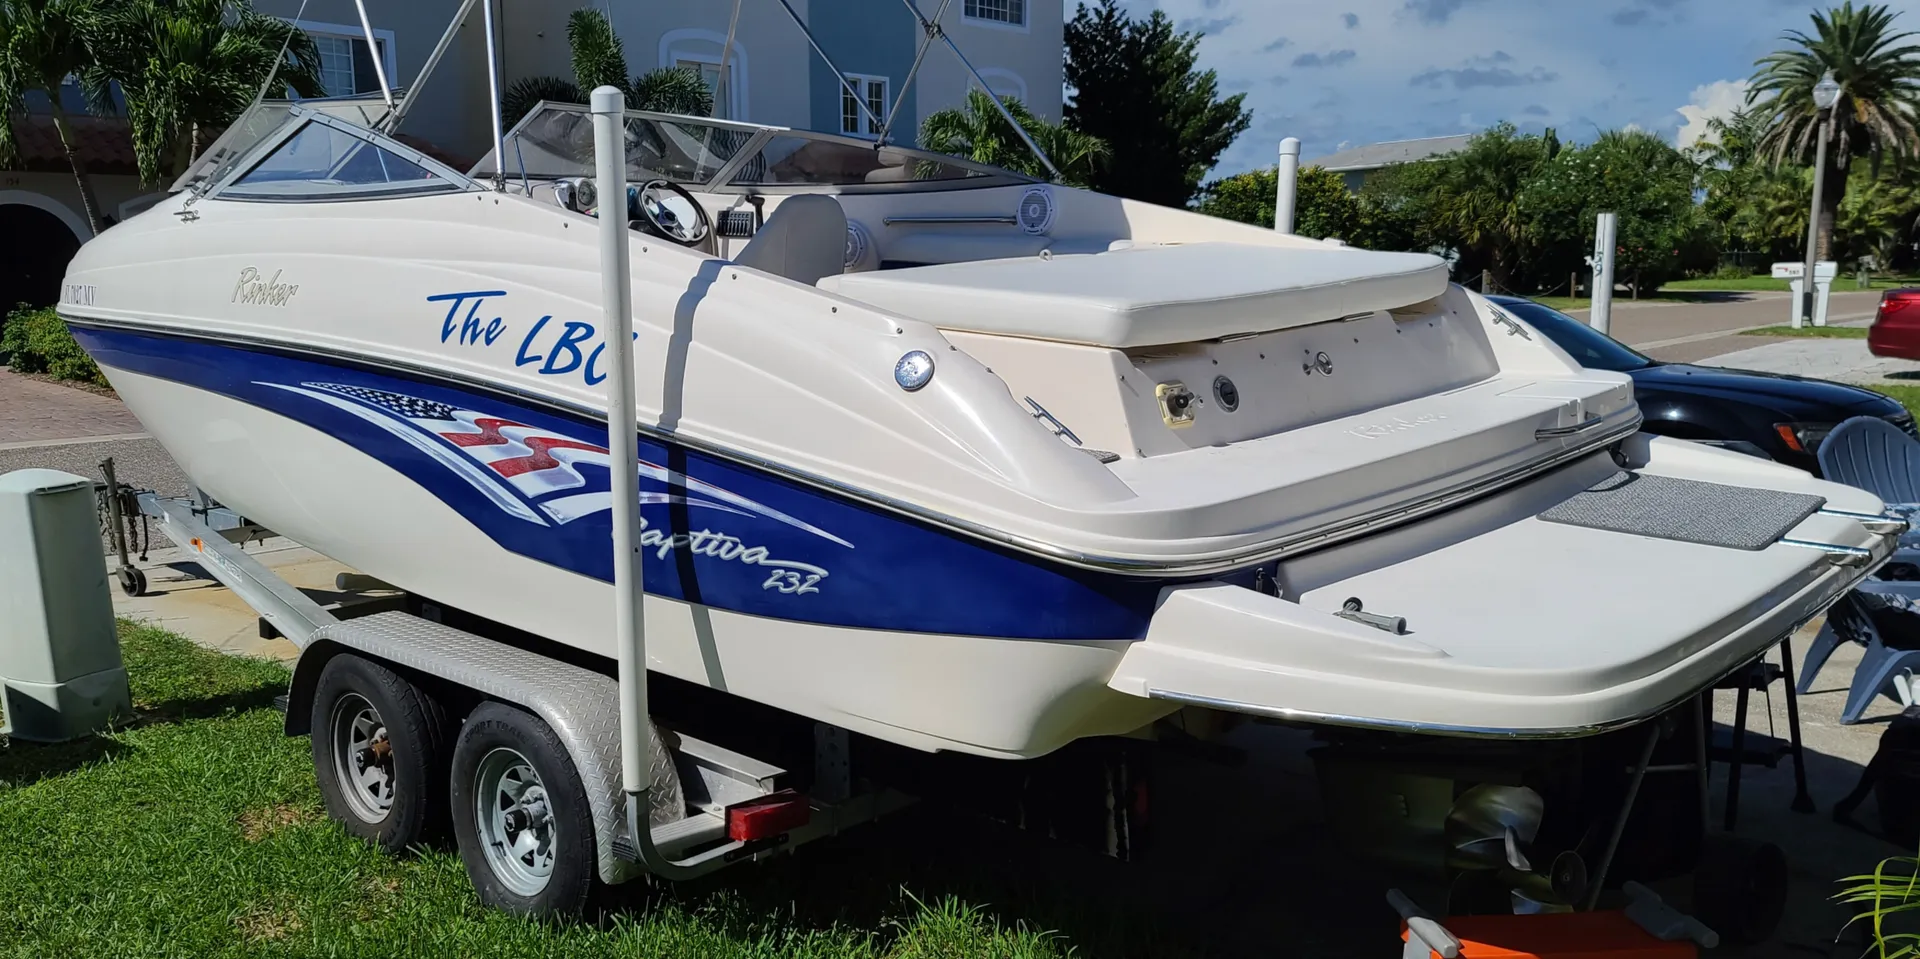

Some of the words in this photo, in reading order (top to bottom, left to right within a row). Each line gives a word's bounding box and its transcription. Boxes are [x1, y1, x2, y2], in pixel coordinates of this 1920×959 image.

[231, 266, 299, 306] Rinker
[426, 290, 507, 347] The
[611, 516, 829, 578] aptiva
[762, 569, 820, 596] 232
[464, 720, 492, 745] SPORT
